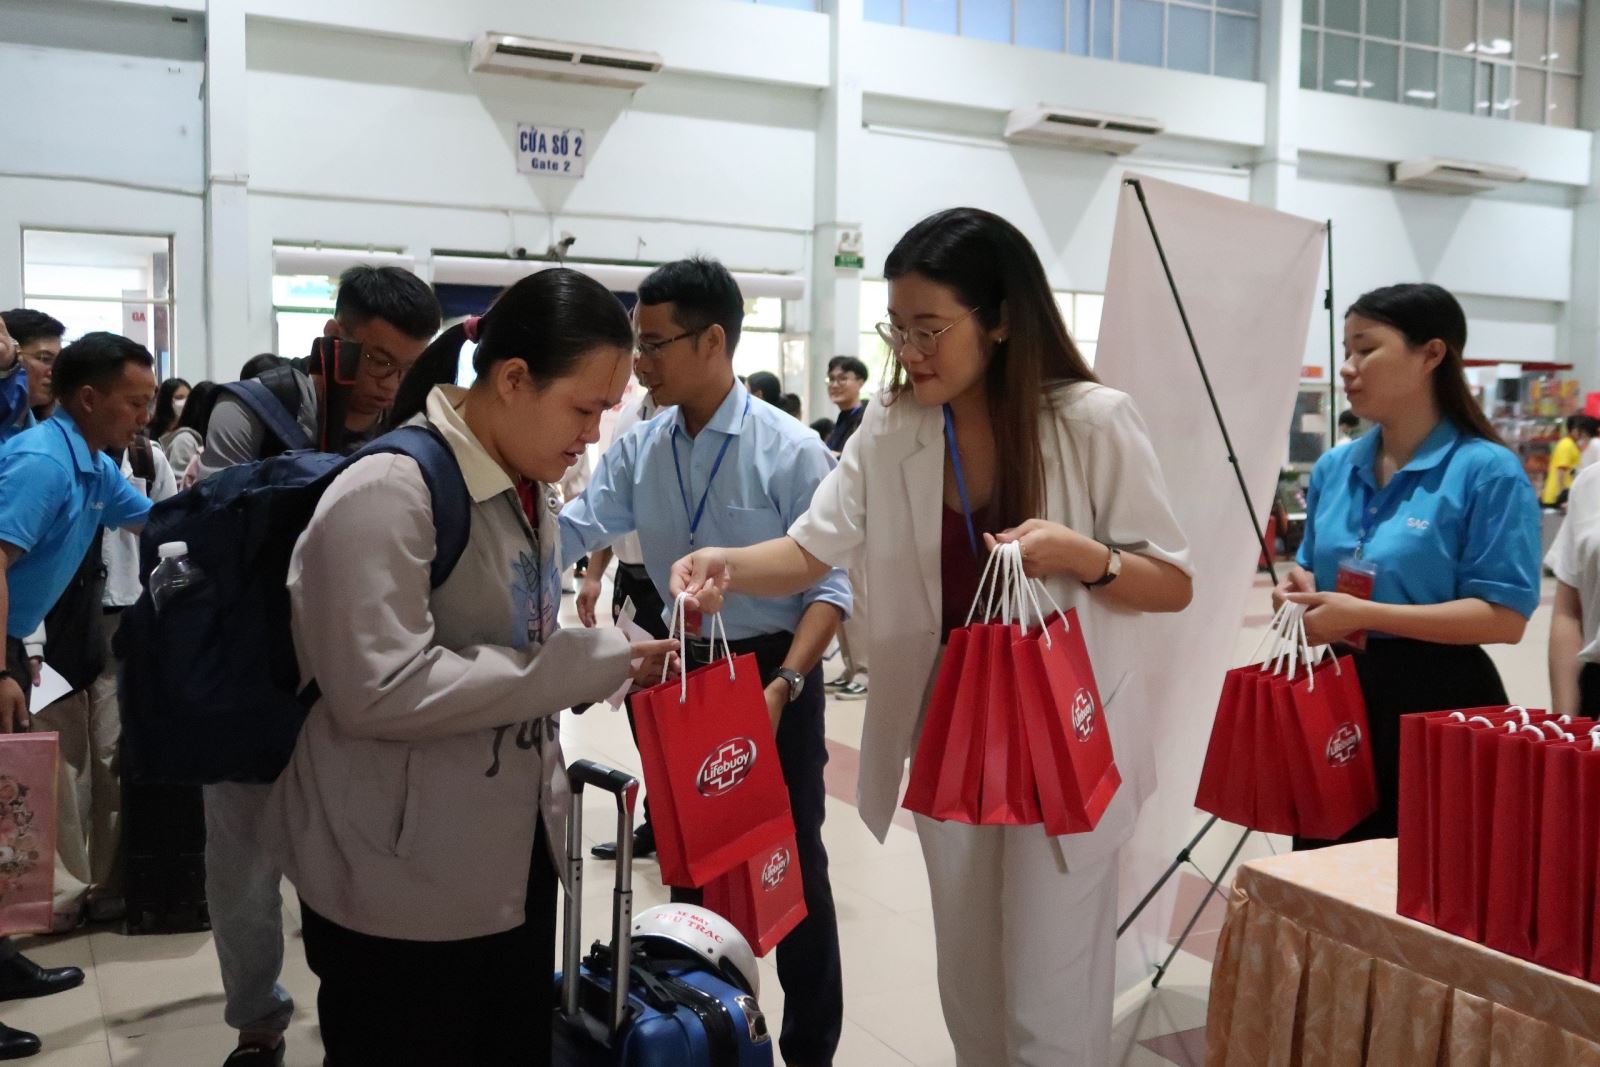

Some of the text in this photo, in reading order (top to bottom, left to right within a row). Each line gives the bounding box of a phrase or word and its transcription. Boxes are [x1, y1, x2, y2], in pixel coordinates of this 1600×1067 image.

[552, 128, 569, 156] SỐ
[574, 136, 582, 157] 2
[531, 157, 571, 172] Gate 2
[703, 752, 750, 782] Lifebuoy
